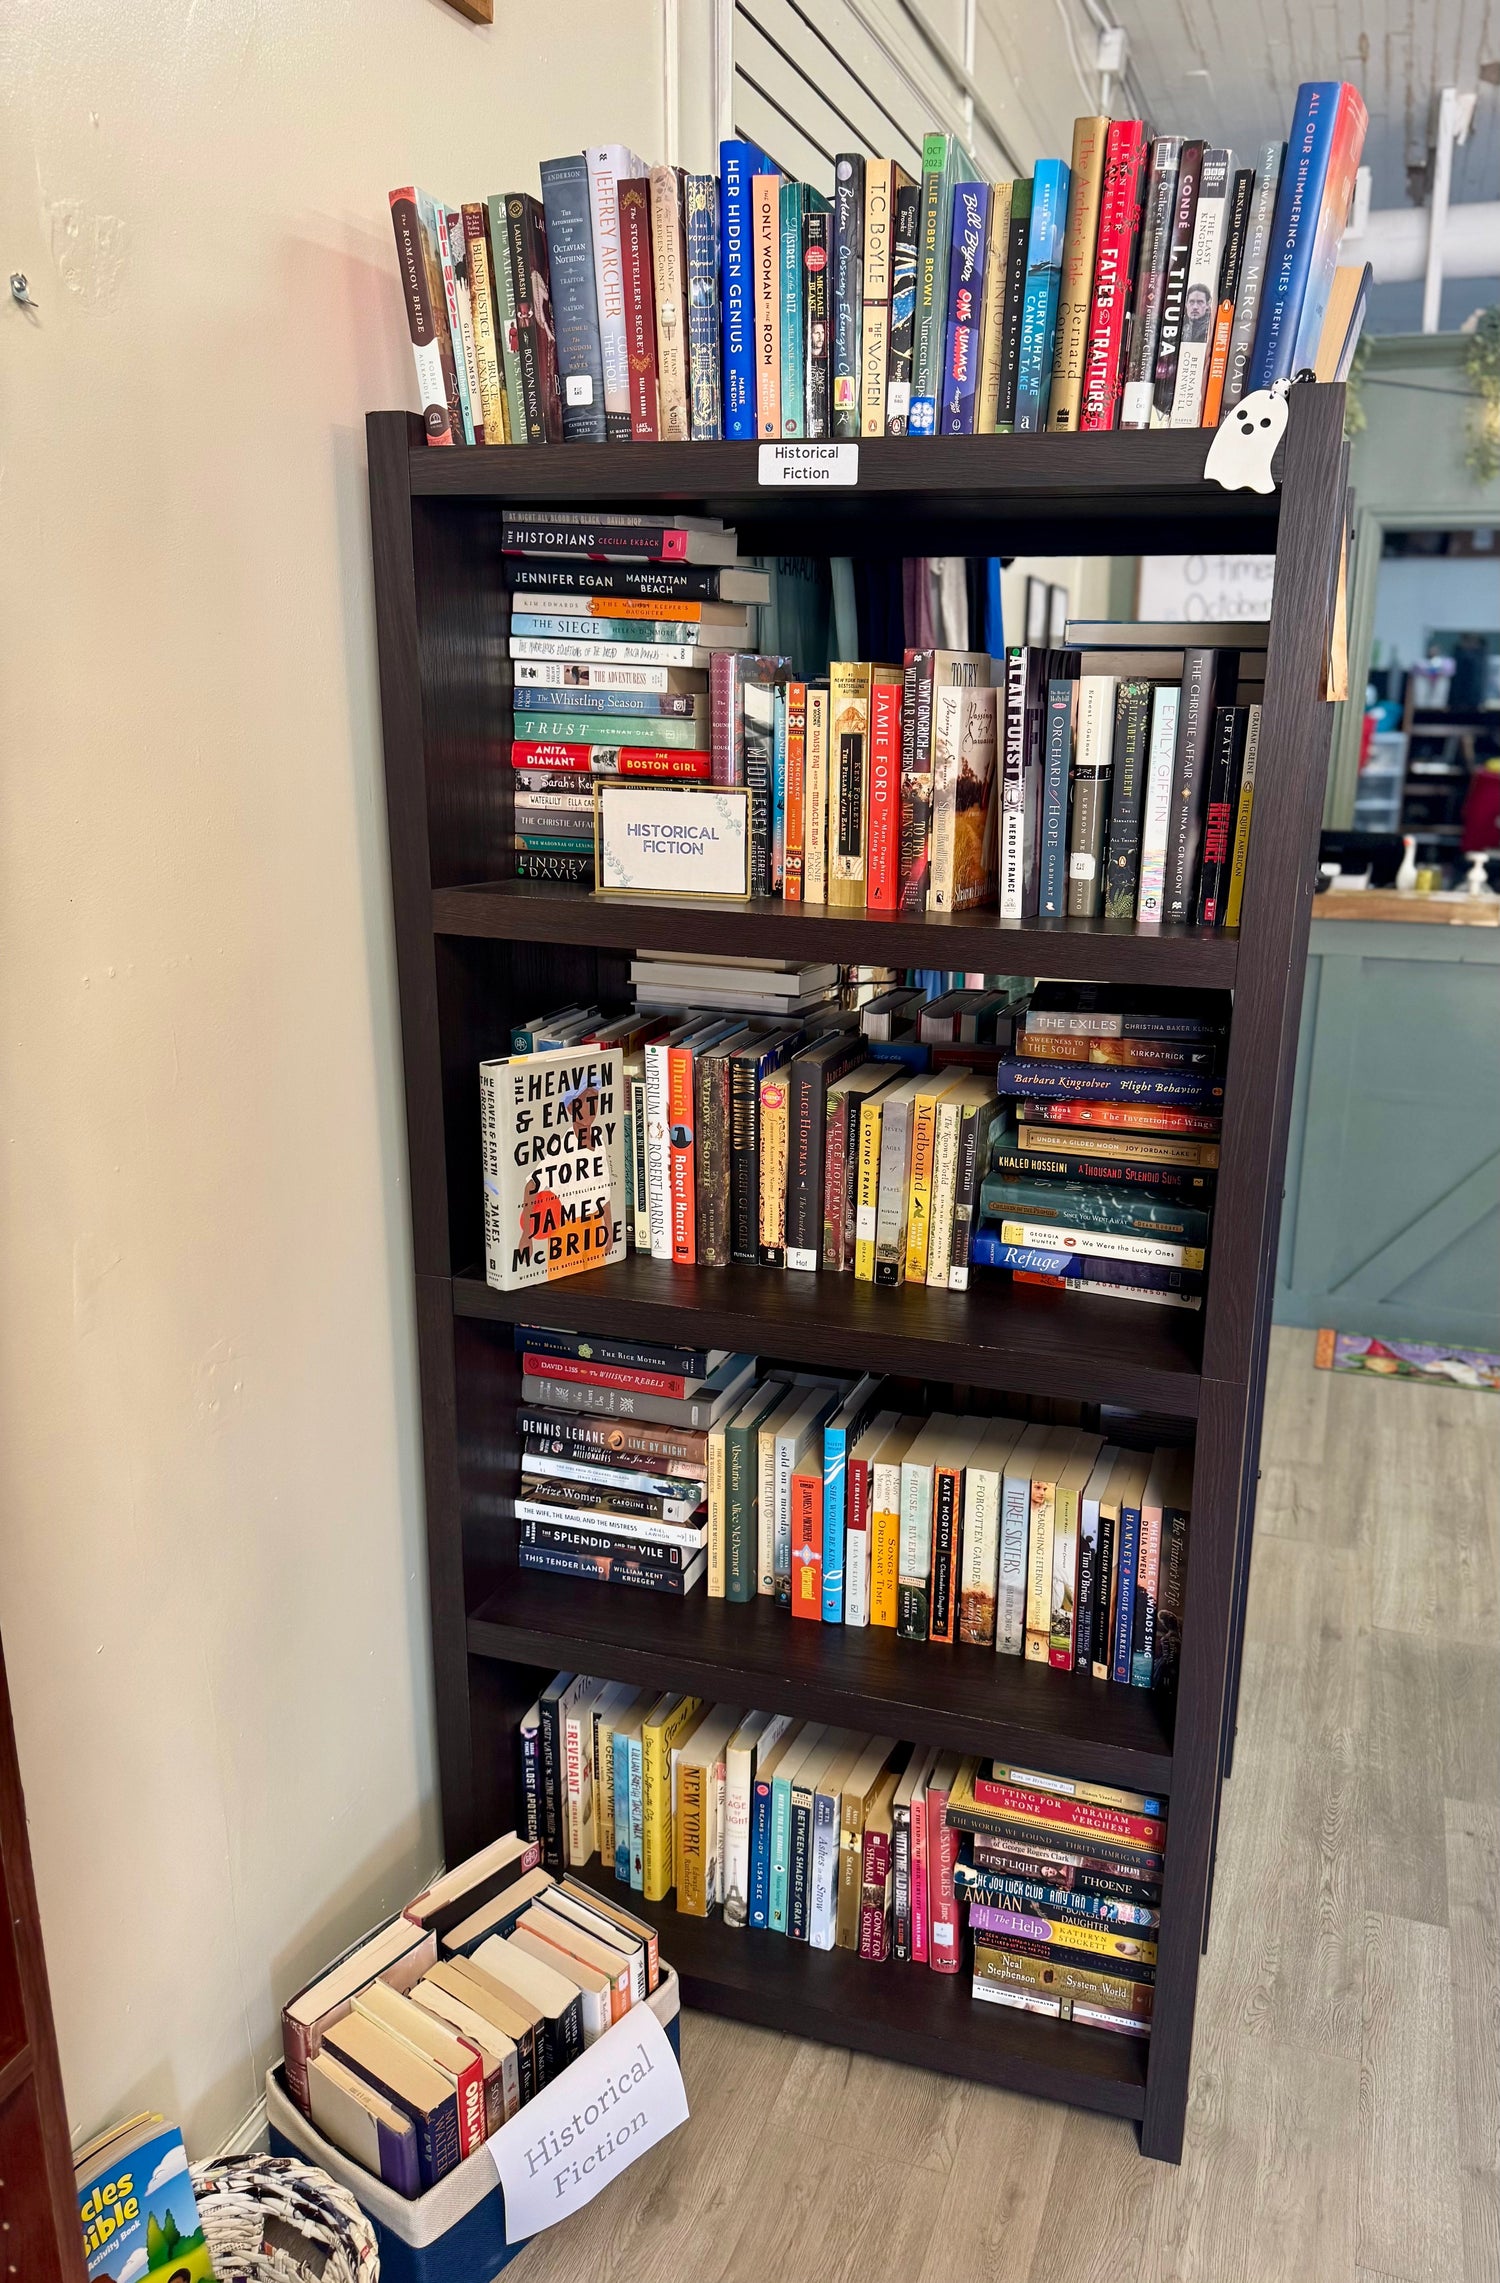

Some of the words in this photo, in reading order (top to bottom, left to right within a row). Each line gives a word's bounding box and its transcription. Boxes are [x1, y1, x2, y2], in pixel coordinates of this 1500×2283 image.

[1308, 92, 1319, 116] ALL
[927, 147, 942, 155] OCT
[1079, 133, 1095, 168] The
[1304, 123, 1316, 151] OUR
[726, 160, 739, 198] HER
[925, 159, 943, 168] 2023
[594, 169, 617, 248] JEFFREY
[871, 182, 885, 214] T.C.
[964, 194, 978, 227] Bill
[1072, 170, 1092, 248] Archer's
[1178, 175, 1193, 229] CONDÉ
[1287, 158, 1310, 249] SHIMMERING
[762, 204, 771, 240] ONLY
[728, 204, 741, 278] HIDDEN
[869, 223, 885, 283] BOYLE
[961, 231, 979, 282] Bryson
[402, 229, 418, 292] ROMANOV
[412, 295, 425, 334] BRIDE
[630, 224, 642, 309] STORYTELLER'S
[763, 246, 772, 300] WOMAN
[1068, 251, 1086, 286] Tale
[1097, 249, 1119, 308] FATES
[1279, 254, 1293, 292] SKIES
[601, 249, 621, 319] ARCHER
[1239, 266, 1259, 332] MERCY
[729, 286, 742, 353] GENIUS
[958, 289, 972, 322] ONE
[1038, 291, 1047, 329] BURY
[1160, 267, 1185, 357] TITUBA
[635, 311, 645, 355] SECRET
[1023, 297, 1036, 353] CANNOT
[1052, 302, 1071, 380] Cornwell
[1067, 303, 1087, 380] Bernard
[763, 325, 773, 365] ROOM
[954, 326, 969, 382] SUMMER
[1033, 333, 1044, 375] WHAT
[524, 348, 535, 389] BOLEYN
[867, 340, 883, 408] WOMEN
[1019, 357, 1029, 391] TAKE
[1088, 329, 1111, 413] TRAITORS
[1230, 341, 1249, 394] ROAD
[529, 392, 538, 417] KING
[737, 377, 745, 405] MARIE
[1029, 379, 1038, 397] WE
[775, 447, 839, 459] Historical
[783, 467, 829, 480] Fiction
[517, 532, 595, 546] HISTORIANS
[598, 537, 627, 546] CECILIA
[515, 572, 574, 585] JENNIFER
[579, 575, 613, 587] EGAN
[626, 574, 687, 584] MANHATTAN
[641, 584, 673, 594] BEACH
[532, 619, 553, 629] THE
[558, 621, 599, 635] SIEGE
[1008, 655, 1024, 708] ALAN
[1190, 658, 1202, 683] THE
[537, 694, 548, 703] The
[550, 692, 604, 709] Whistling
[607, 695, 643, 709] Season
[1187, 686, 1201, 737] CHRISTIE
[525, 721, 590, 736] TRUST
[876, 693, 890, 746] JAMIE
[536, 744, 567, 756] ANITA
[1006, 714, 1023, 775] FURST
[1221, 713, 1234, 766] GRATZ
[527, 756, 575, 767] DIAMANT
[627, 760, 668, 771] BOSTON
[673, 760, 697, 772] GIRL
[1182, 741, 1196, 780] AFFAIR
[874, 756, 888, 802] FORD
[627, 824, 720, 841] HISTORICAL
[643, 841, 704, 855] FICTION
[1008, 825, 1016, 847] HERO
[520, 858, 587, 871] LINDSEY
[1008, 850, 1015, 859] OF
[530, 867, 578, 880] DAVIS
[1006, 862, 1016, 893] FRANCE
[1037, 1018, 1065, 1029] THE
[1070, 1019, 1117, 1030] EXILES
[514, 1076, 524, 1105] THE
[528, 1062, 613, 1095] HEAVEN
[672, 1059, 686, 1116] Munich
[1014, 1074, 1055, 1086] Barbara
[1058, 1076, 1111, 1089] Kingsolver
[1120, 1080, 1151, 1093] Flight
[1155, 1083, 1202, 1095] Behavior
[542, 1093, 614, 1128] EARTH
[514, 1123, 616, 1166] GROCERY
[864, 1124, 872, 1165] LOVING
[913, 1104, 932, 1192] Mudbound
[966, 1134, 974, 1167] orphan
[530, 1156, 604, 1194] STORE
[649, 1142, 661, 1188] ROBERT
[675, 1155, 686, 1194] Robert
[963, 1169, 971, 1191] train
[999, 1156, 1029, 1170] KHALED
[1031, 1159, 1068, 1173] HOSSEINI
[862, 1170, 870, 1206] FRANK
[529, 1197, 606, 1238] JAMES
[651, 1192, 665, 1237] HARRIS
[676, 1198, 686, 1243] Harris
[1029, 1231, 1059, 1239] GEORGIA
[1031, 1238, 1056, 1246] HUNTER
[1132, 1245, 1153, 1256] Lucky
[1155, 1249, 1175, 1257] Ones
[1004, 1247, 1060, 1270] Refuge
[523, 1419, 561, 1438] DENNIS
[566, 1427, 604, 1444] LEHANE
[628, 1439, 646, 1450] LIVE
[650, 1442, 660, 1452] BY
[662, 1444, 687, 1457] NIGHT
[942, 1478, 951, 1503] KATE
[1007, 1490, 1024, 1526] THREE
[940, 1506, 951, 1547] MORTON
[1122, 1514, 1134, 1566] HAMNET
[554, 1531, 610, 1549] SPLENDID
[639, 1546, 663, 1558] VILE
[877, 1520, 886, 1574] ORDINARY
[888, 1538, 896, 1573] SONGS
[1003, 1528, 1022, 1574] SISTERS
[1082, 1551, 1092, 1568] Tim
[525, 1554, 543, 1563] THIS
[546, 1557, 579, 1569] TENDER
[581, 1561, 604, 1572] LAND
[614, 1565, 642, 1577] WILLIAM
[645, 1570, 663, 1580] KENT
[622, 1574, 655, 1586] KRUEGER
[876, 1579, 884, 1605] TIME
[886, 1578, 893, 1590] IN
[1079, 1566, 1091, 1602] O'Brien
[567, 1731, 580, 1794] REVENANT
[684, 1767, 700, 1797] NEW
[985, 1785, 1035, 1802] CUTTING
[1040, 1798, 1061, 1809] FOR
[1004, 1800, 1040, 1813] STONE
[1075, 1807, 1129, 1824] ABRAHAM
[683, 1808, 700, 1856] YORK
[1072, 1814, 1131, 1834] VERGHESE
[980, 1854, 1007, 1866] FIRST
[1010, 1859, 1039, 1873] LIGHT
[1082, 1875, 1132, 1895] THOENE
[994, 1914, 1010, 1925] The
[1011, 1917, 1043, 1936] Help
[1059, 1927, 1107, 1943] KATHRYN
[1058, 1935, 1107, 1951] STOCKETT
[987, 1963, 1035, 1984] Stephenson
[1002, 1956, 1022, 1970] Neal
[1067, 1975, 1097, 1991] System
[1102, 1982, 1127, 1998] World
[524, 2045, 654, 2179] Historical
[555, 2109, 649, 2198] Fiction
[88, 2240, 119, 2272] Activity
[120, 2220, 141, 2240] Book
